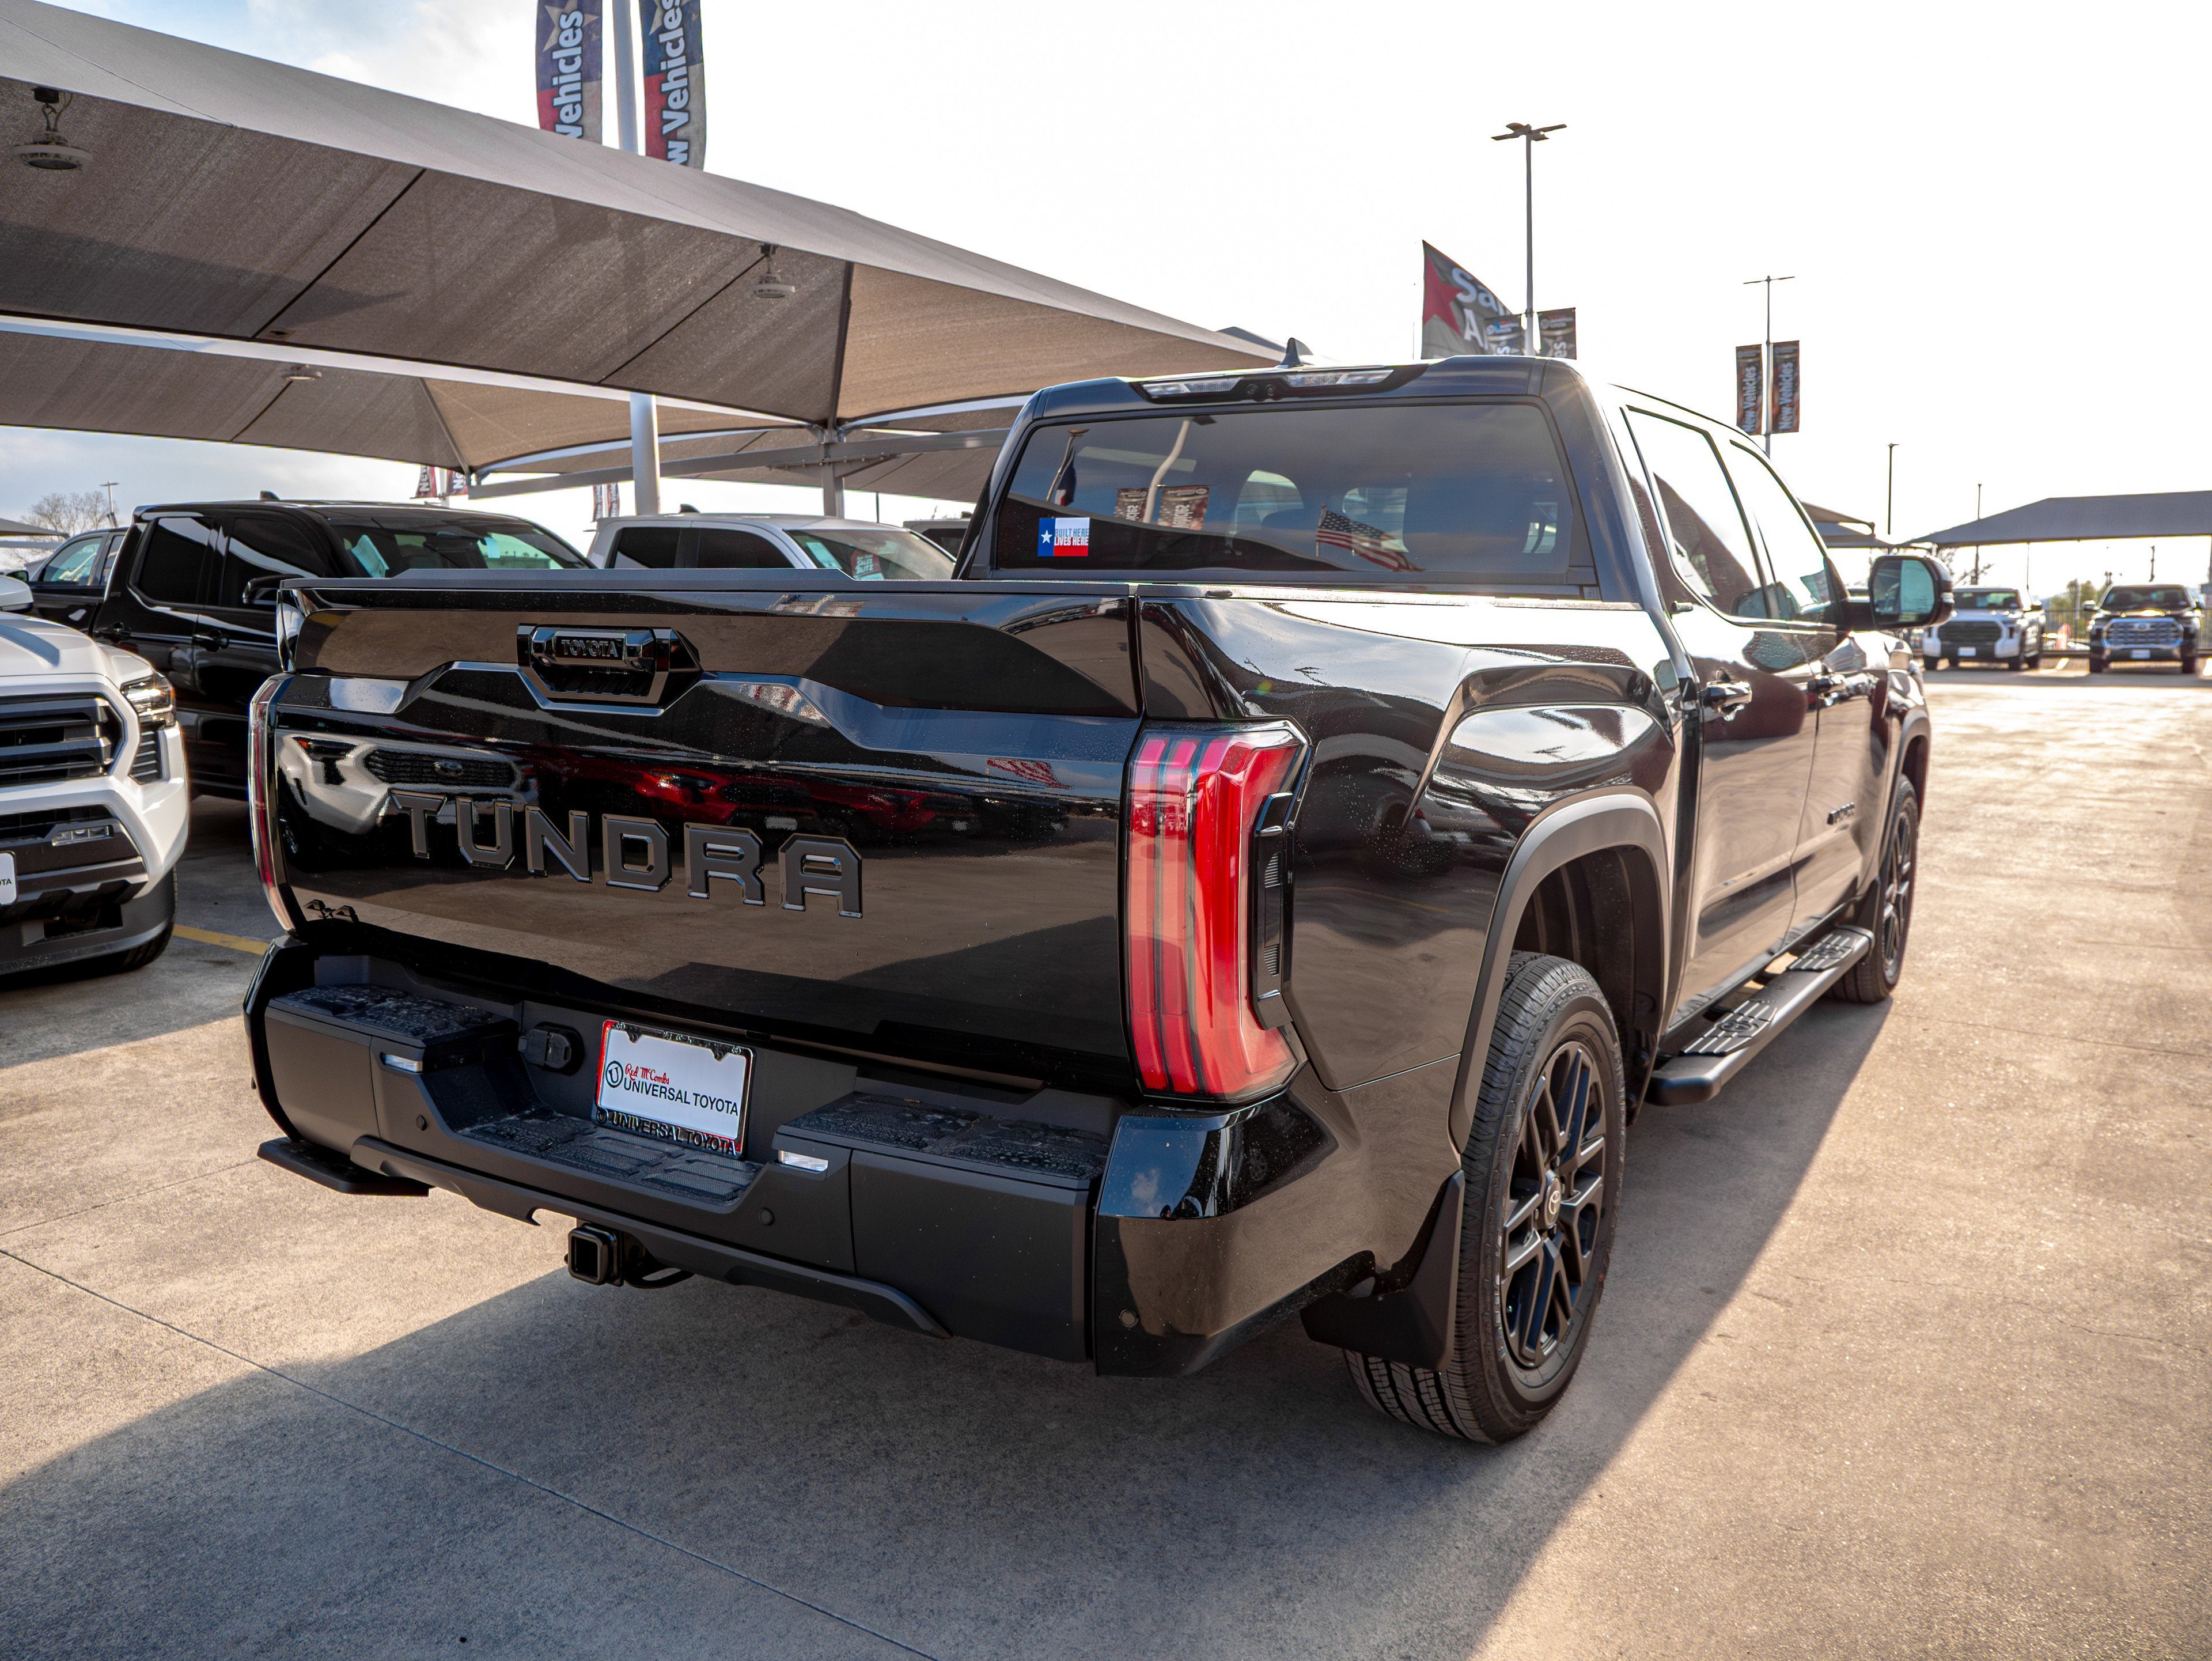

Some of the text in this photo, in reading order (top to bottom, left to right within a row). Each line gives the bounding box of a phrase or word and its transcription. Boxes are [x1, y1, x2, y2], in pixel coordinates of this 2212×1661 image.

[1778, 362, 1794, 406] Vehicles
[1054, 537, 1089, 546] LIVES HERE
[1055, 528, 1089, 537] BUILT HERE
[561, 639, 619, 657] TOYOTA
[389, 788, 863, 919] TUNDRA
[625, 1063, 669, 1085] Red McCombs
[623, 1077, 738, 1116] UNIVERSAL TOYOTA
[612, 1111, 737, 1156] UNIVERSAL TOYOTA
